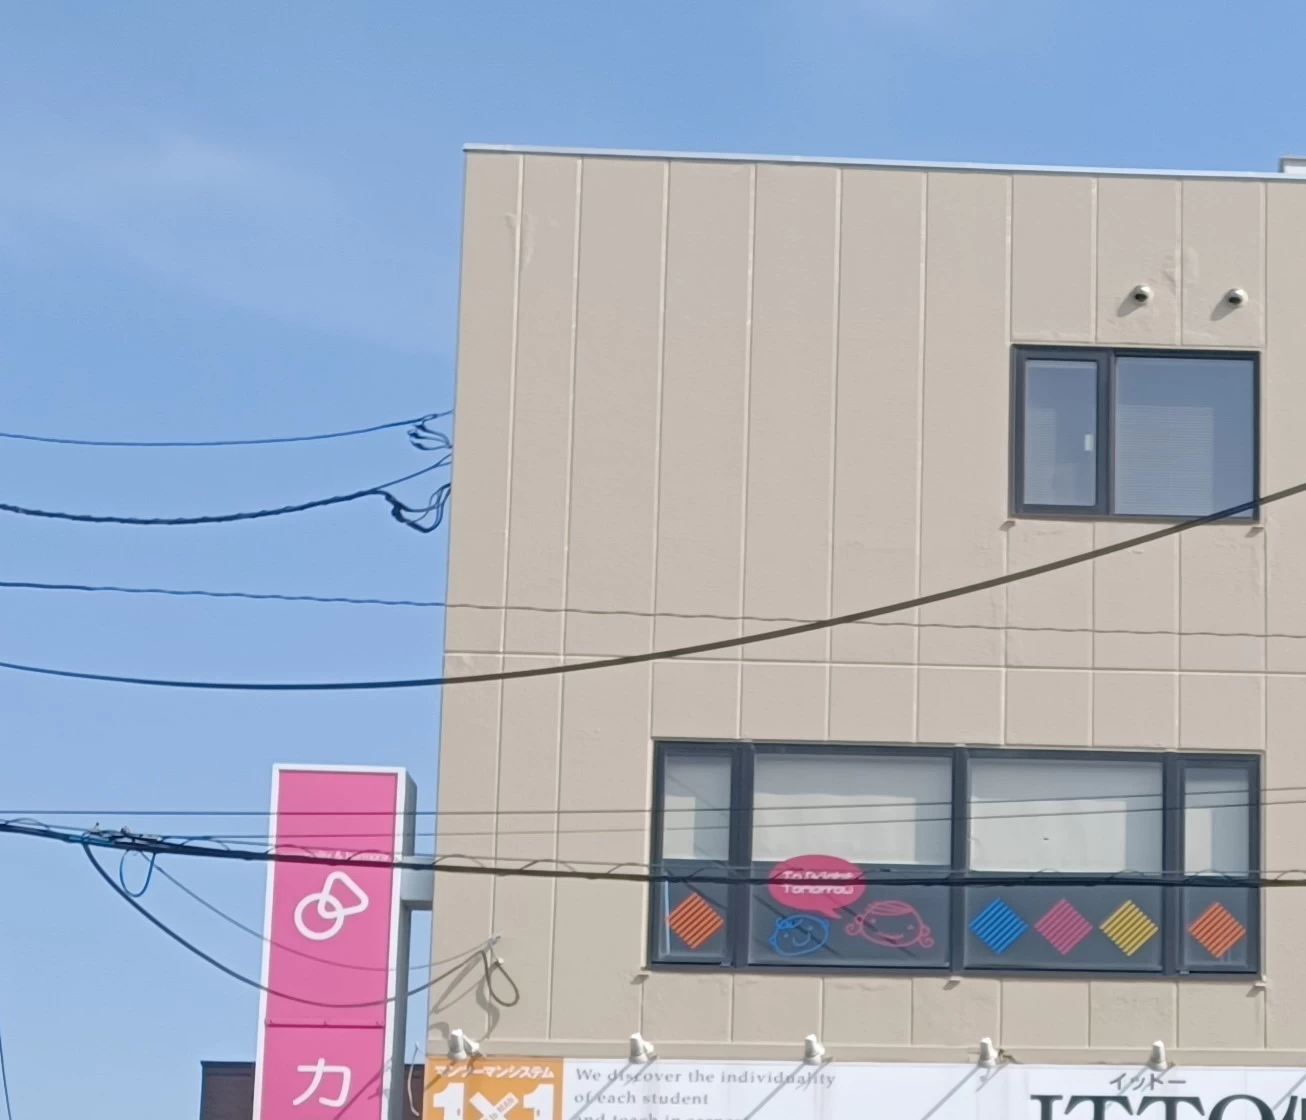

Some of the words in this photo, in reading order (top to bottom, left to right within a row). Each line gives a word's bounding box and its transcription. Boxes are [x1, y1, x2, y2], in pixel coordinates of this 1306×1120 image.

[576, 1068, 601, 1081] We
[607, 1068, 681, 1083] discover
[688, 1069, 715, 1083] the
[720, 1070, 835, 1087] individuality
[1110, 1074, 1186, 1092] イットー
[574, 1091, 593, 1104] of
[597, 1091, 636, 1104] each
[642, 1092, 709, 1105] student
